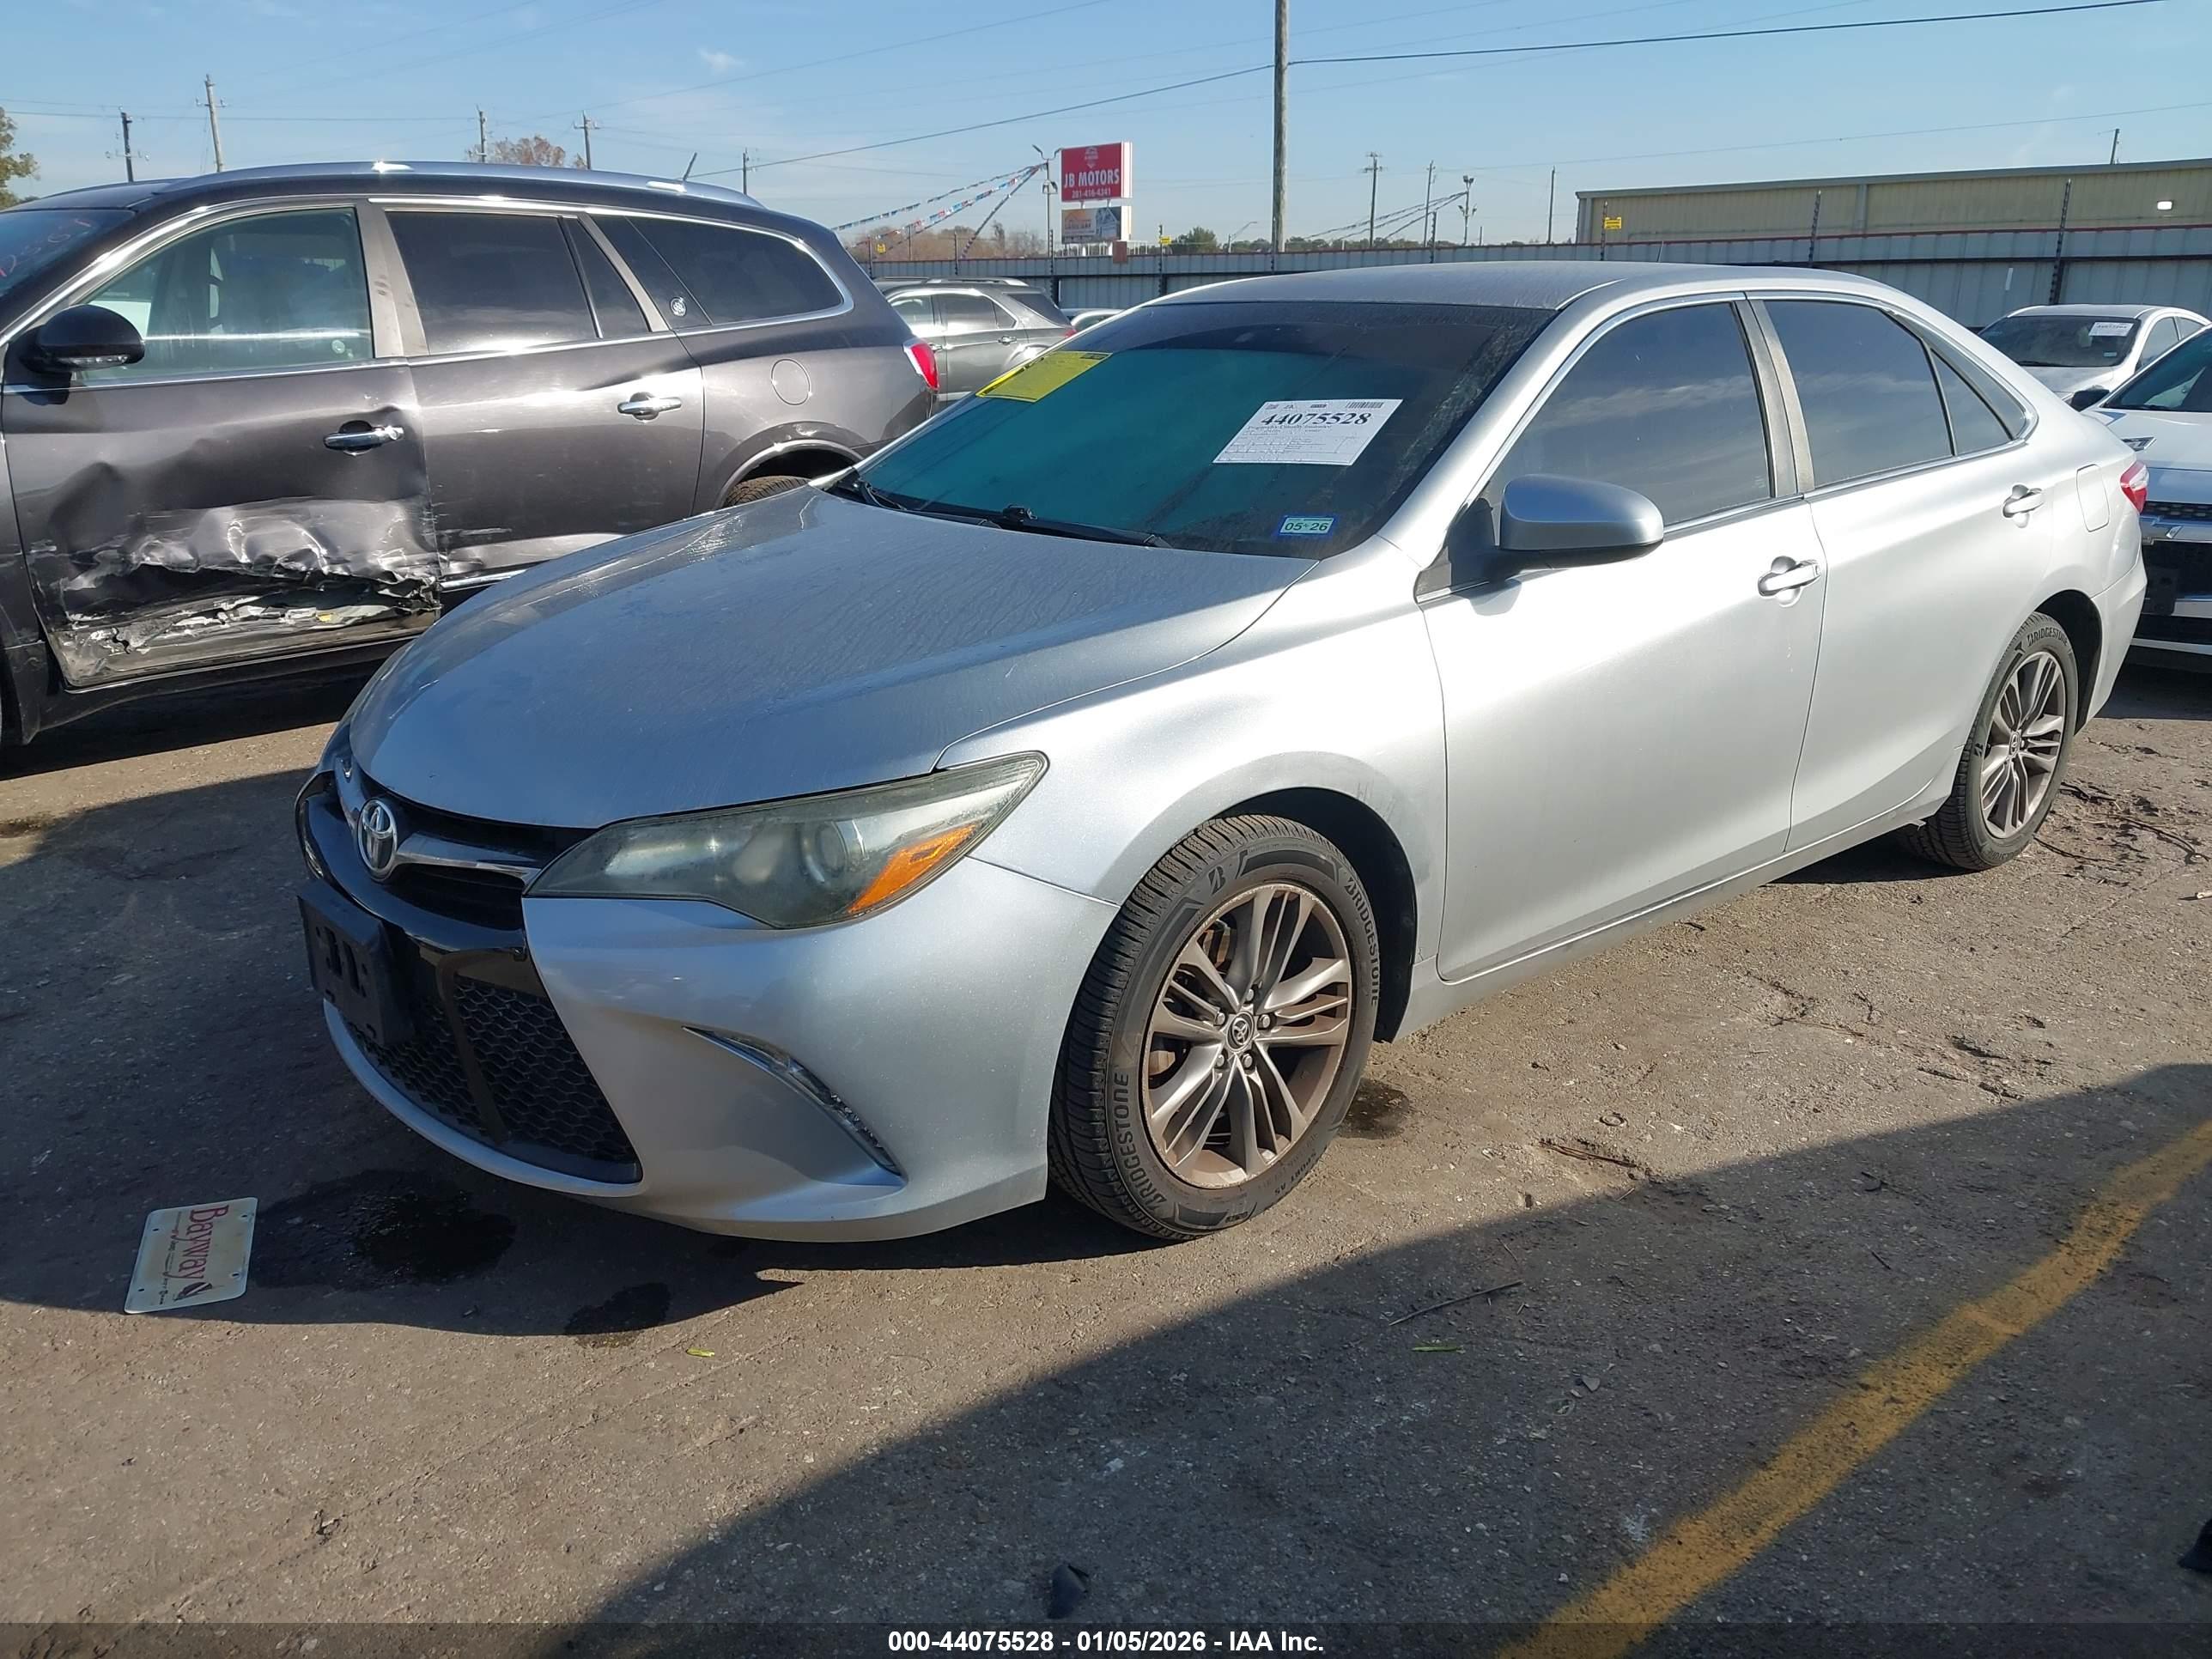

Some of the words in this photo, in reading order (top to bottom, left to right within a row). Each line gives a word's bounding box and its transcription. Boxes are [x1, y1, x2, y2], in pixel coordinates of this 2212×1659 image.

[1064, 173, 1075, 188] JB
[1078, 168, 1120, 186] MOTORS
[1261, 412, 1372, 425] 44075528
[1285, 522, 1304, 531] 05
[1310, 522, 1329, 531] 26
[2027, 626, 2068, 647] BRIDGESTONE
[1341, 876, 1380, 1006] BRIDGESTONE
[1112, 1072, 1167, 1212] BRIDGESTONE
[162, 1205, 229, 1279] Bayway
